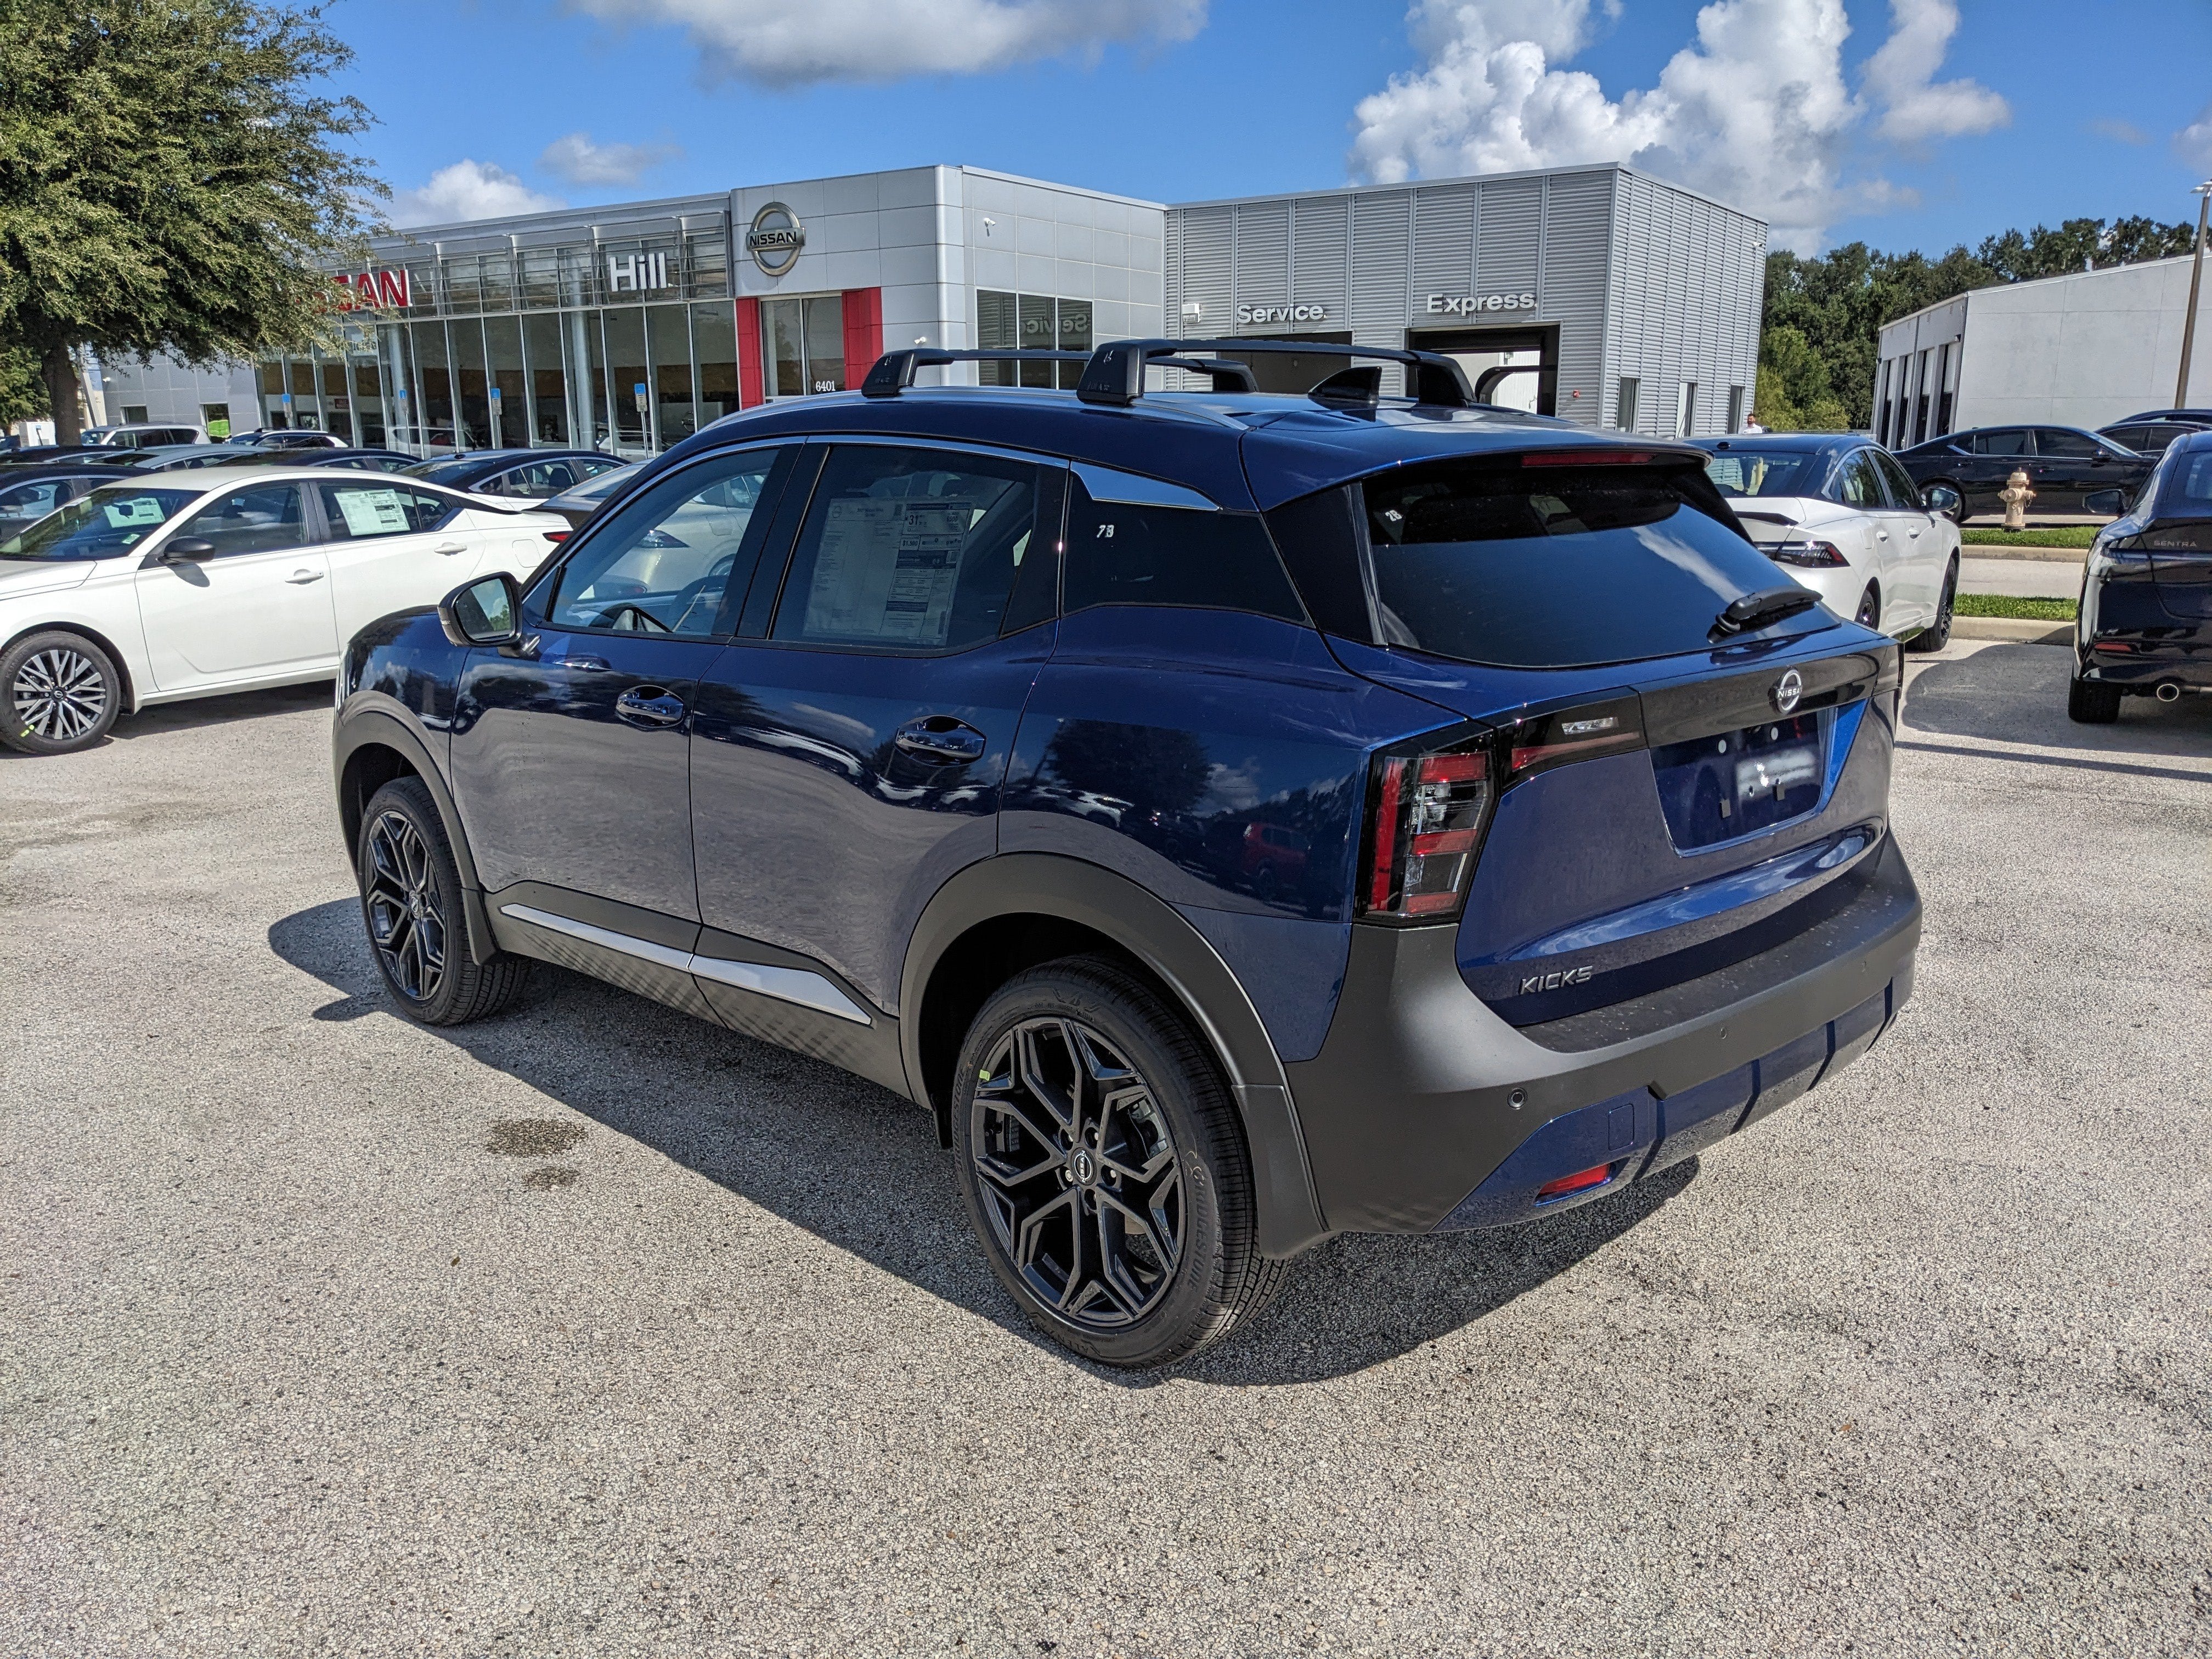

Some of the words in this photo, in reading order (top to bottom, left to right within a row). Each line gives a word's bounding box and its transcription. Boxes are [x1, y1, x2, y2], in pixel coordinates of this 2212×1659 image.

[750, 232, 797, 246] NISSAN
[610, 252, 667, 292] Hill
[1237, 304, 1324, 324] Service
[1427, 293, 1536, 317] Express
[815, 380, 836, 392] 6401
[1520, 966, 1593, 995] KICKS
